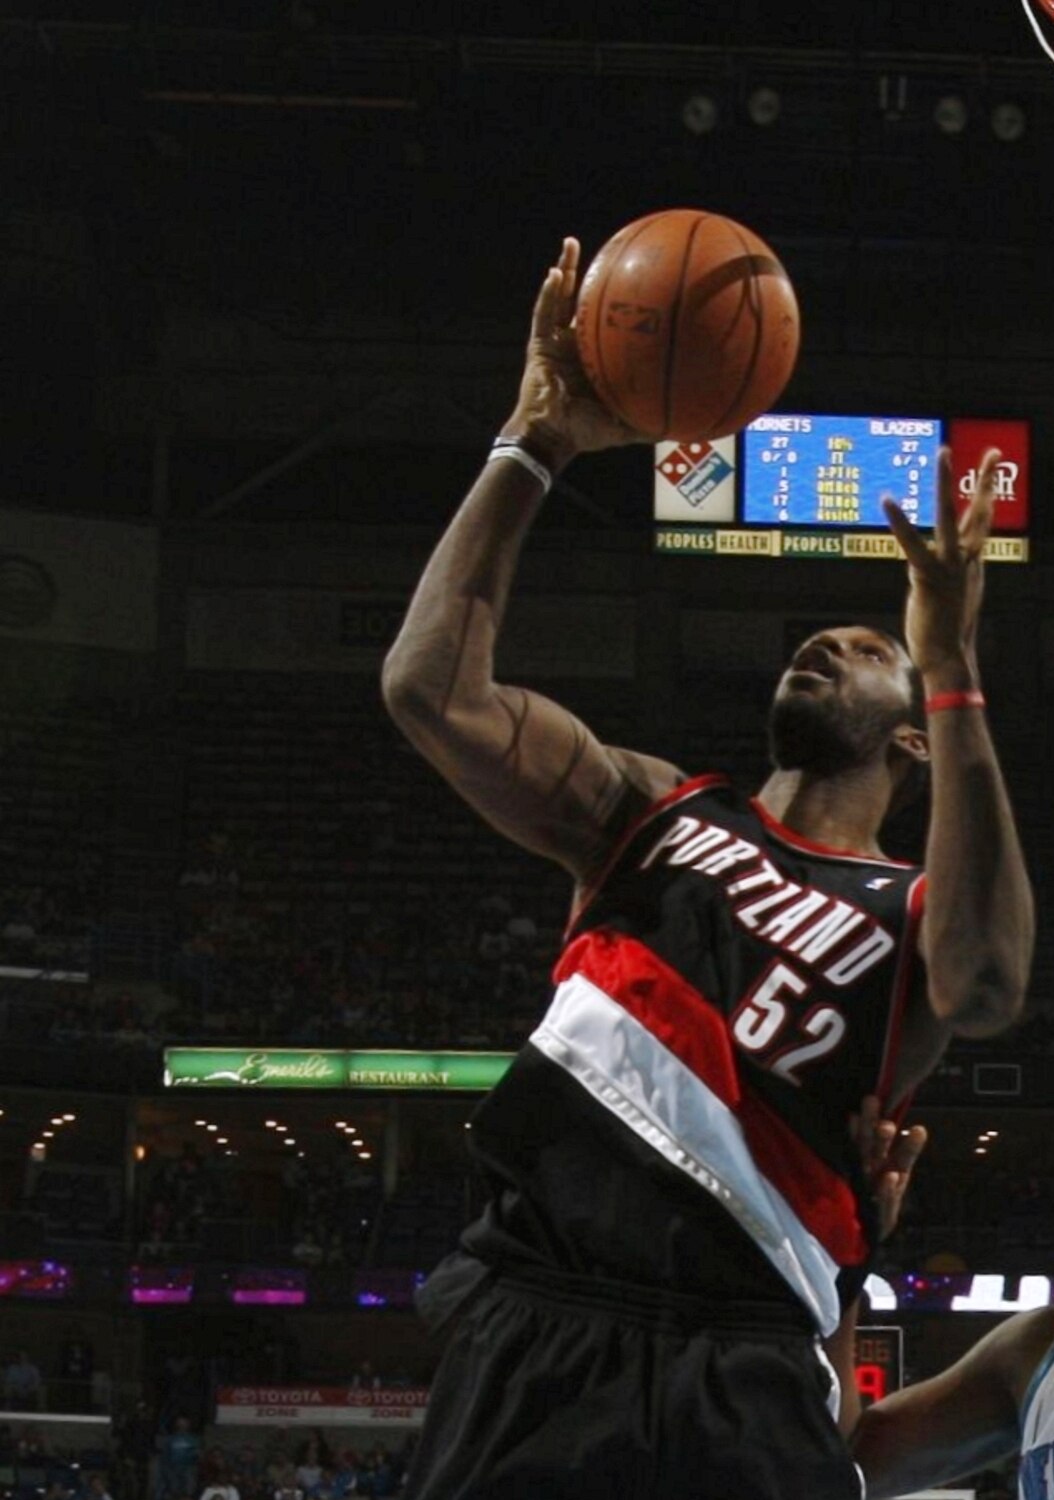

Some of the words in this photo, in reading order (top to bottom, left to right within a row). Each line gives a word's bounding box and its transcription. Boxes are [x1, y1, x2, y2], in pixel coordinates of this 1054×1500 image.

[869, 421, 934, 436] BLAZERS
[771, 436, 788, 449] 27
[902, 441, 919, 453] 27
[657, 533, 714, 549] PEOPLES
[719, 536, 768, 550] HEALTH
[784, 537, 841, 552] PEOPLES
[847, 539, 896, 554] HEALTH
[641, 816, 894, 985] PORTLAND
[733, 964, 845, 1086] 52
[238, 1054, 334, 1083] Emeril's
[350, 1071, 450, 1085] RESTAURANT
[257, 1389, 322, 1404] TOYOTA
[256, 1407, 299, 1417] ZONE
[371, 1408, 413, 1418] ZONE
